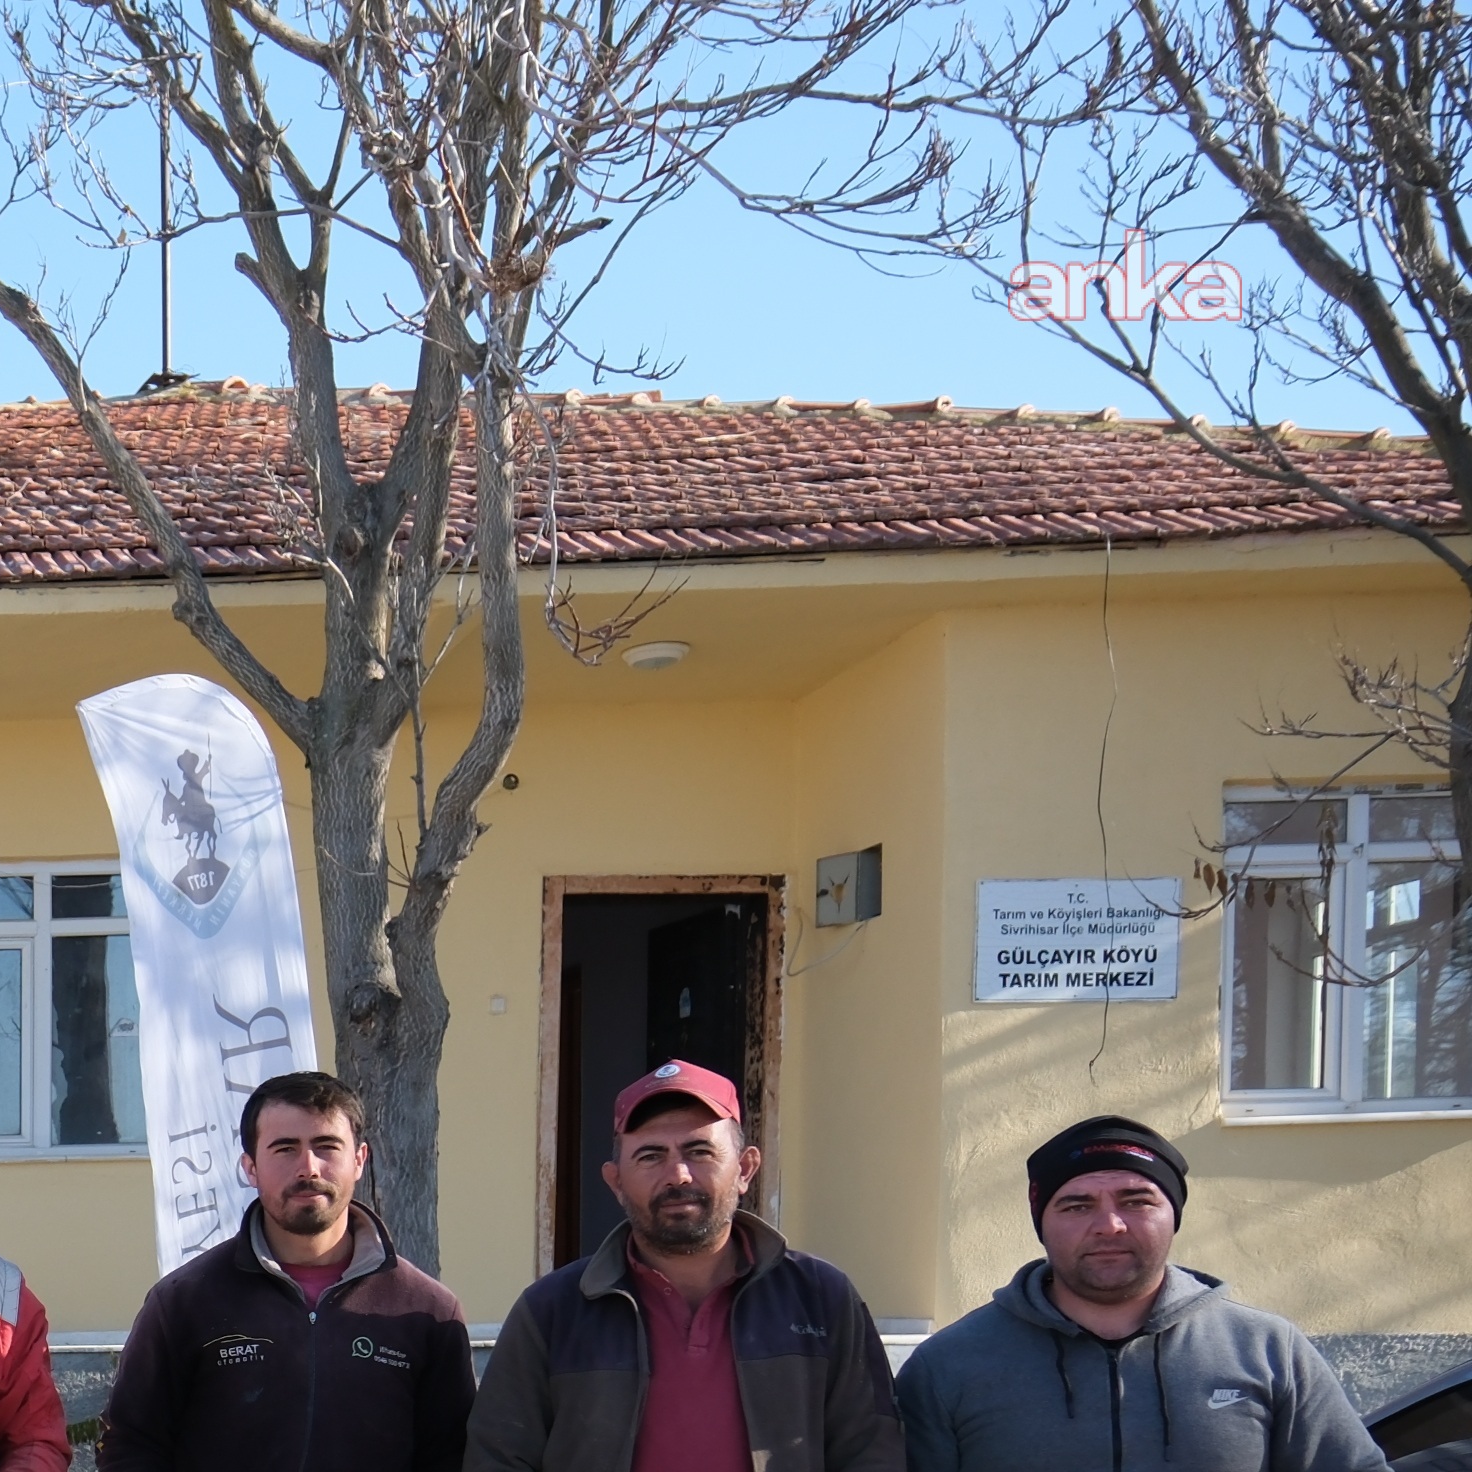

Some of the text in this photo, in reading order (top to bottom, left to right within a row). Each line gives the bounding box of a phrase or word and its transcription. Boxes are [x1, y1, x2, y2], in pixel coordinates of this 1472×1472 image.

[1067, 893, 1088, 904] T.C.
[993, 907, 1165, 922] Tarım ve Köyişleri Bakanlığı
[1001, 924, 1059, 935] Sivrihisar
[1088, 922, 1155, 936] Müdürlüğü
[997, 945, 1157, 968] GÜLÇAYIR KÖYÜ
[999, 968, 1154, 988] TARIM MERKEZİ
[220, 1344, 259, 1358] BERAT
[1212, 1389, 1240, 1400] NIKE
